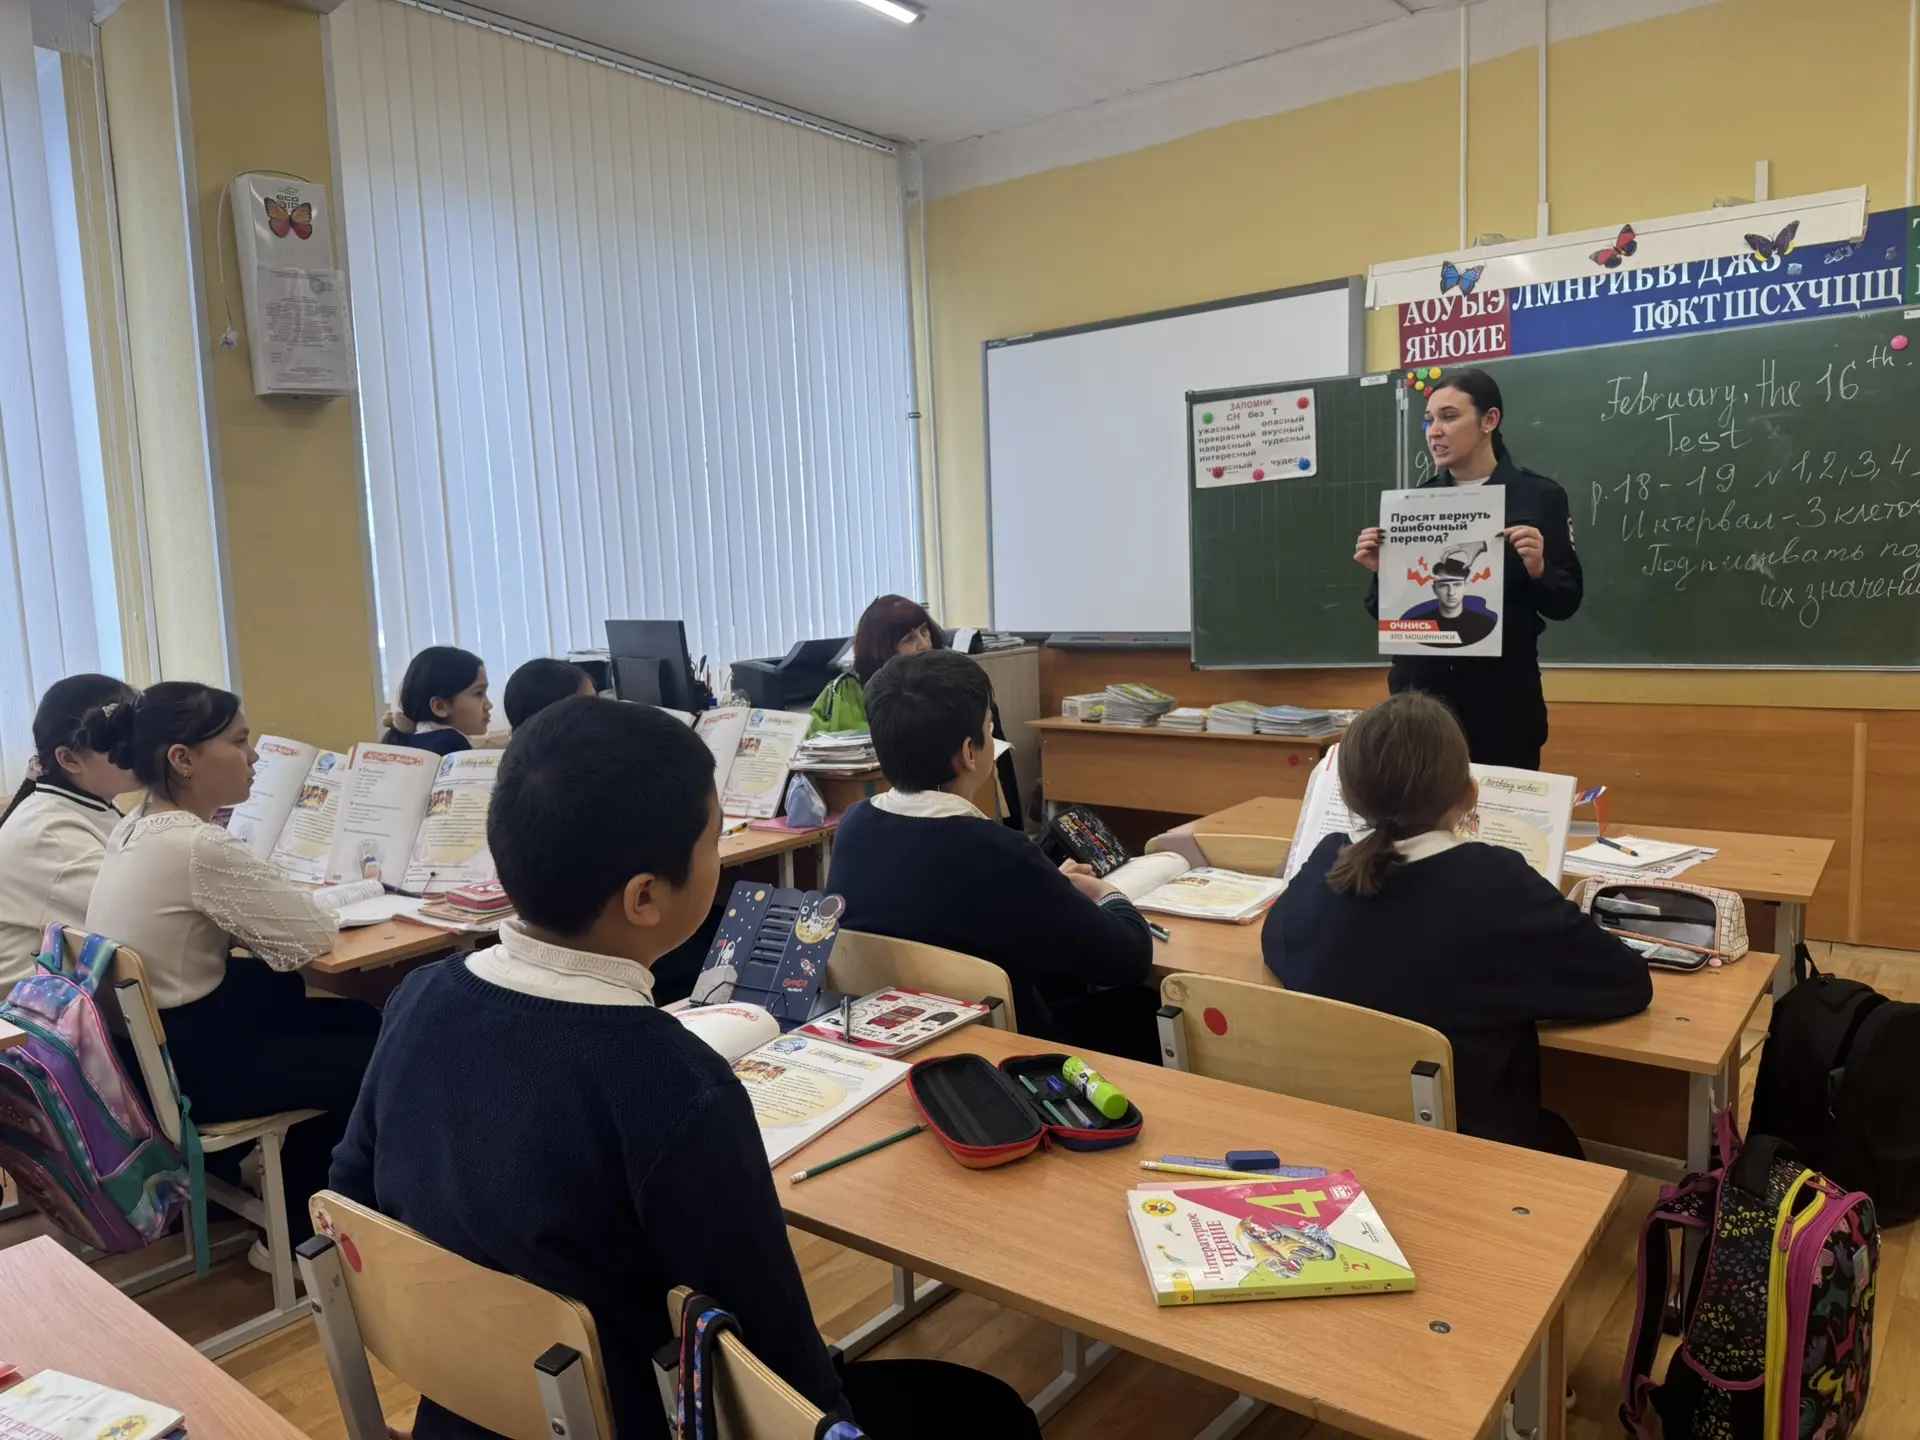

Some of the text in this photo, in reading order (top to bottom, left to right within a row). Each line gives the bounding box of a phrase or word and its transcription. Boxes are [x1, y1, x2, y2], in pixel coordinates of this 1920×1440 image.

[1632, 266, 1902, 333] ПФКТШСХЧЦЩ
[1404, 323, 1507, 364] ЯЁЮИЕ
[1756, 358, 1802, 408] the
[1248, 411, 1264, 419] без
[1198, 416, 1305, 436] ужасный опасный
[1198, 425, 1304, 444] прекрасный вкусный
[1656, 413, 1753, 456] Test
[1199, 435, 1311, 453] напрасный чудесный
[1199, 450, 1257, 463] интересный
[1271, 457, 1304, 467] чудес
[1391, 511, 1491, 524] Просят вернуть
[1390, 522, 1468, 533] ошибочный
[1390, 533, 1449, 545] перевод?
[1245, 1188, 1329, 1219] 4
[1206, 1220, 1239, 1268] ЧТЕНИЕ
